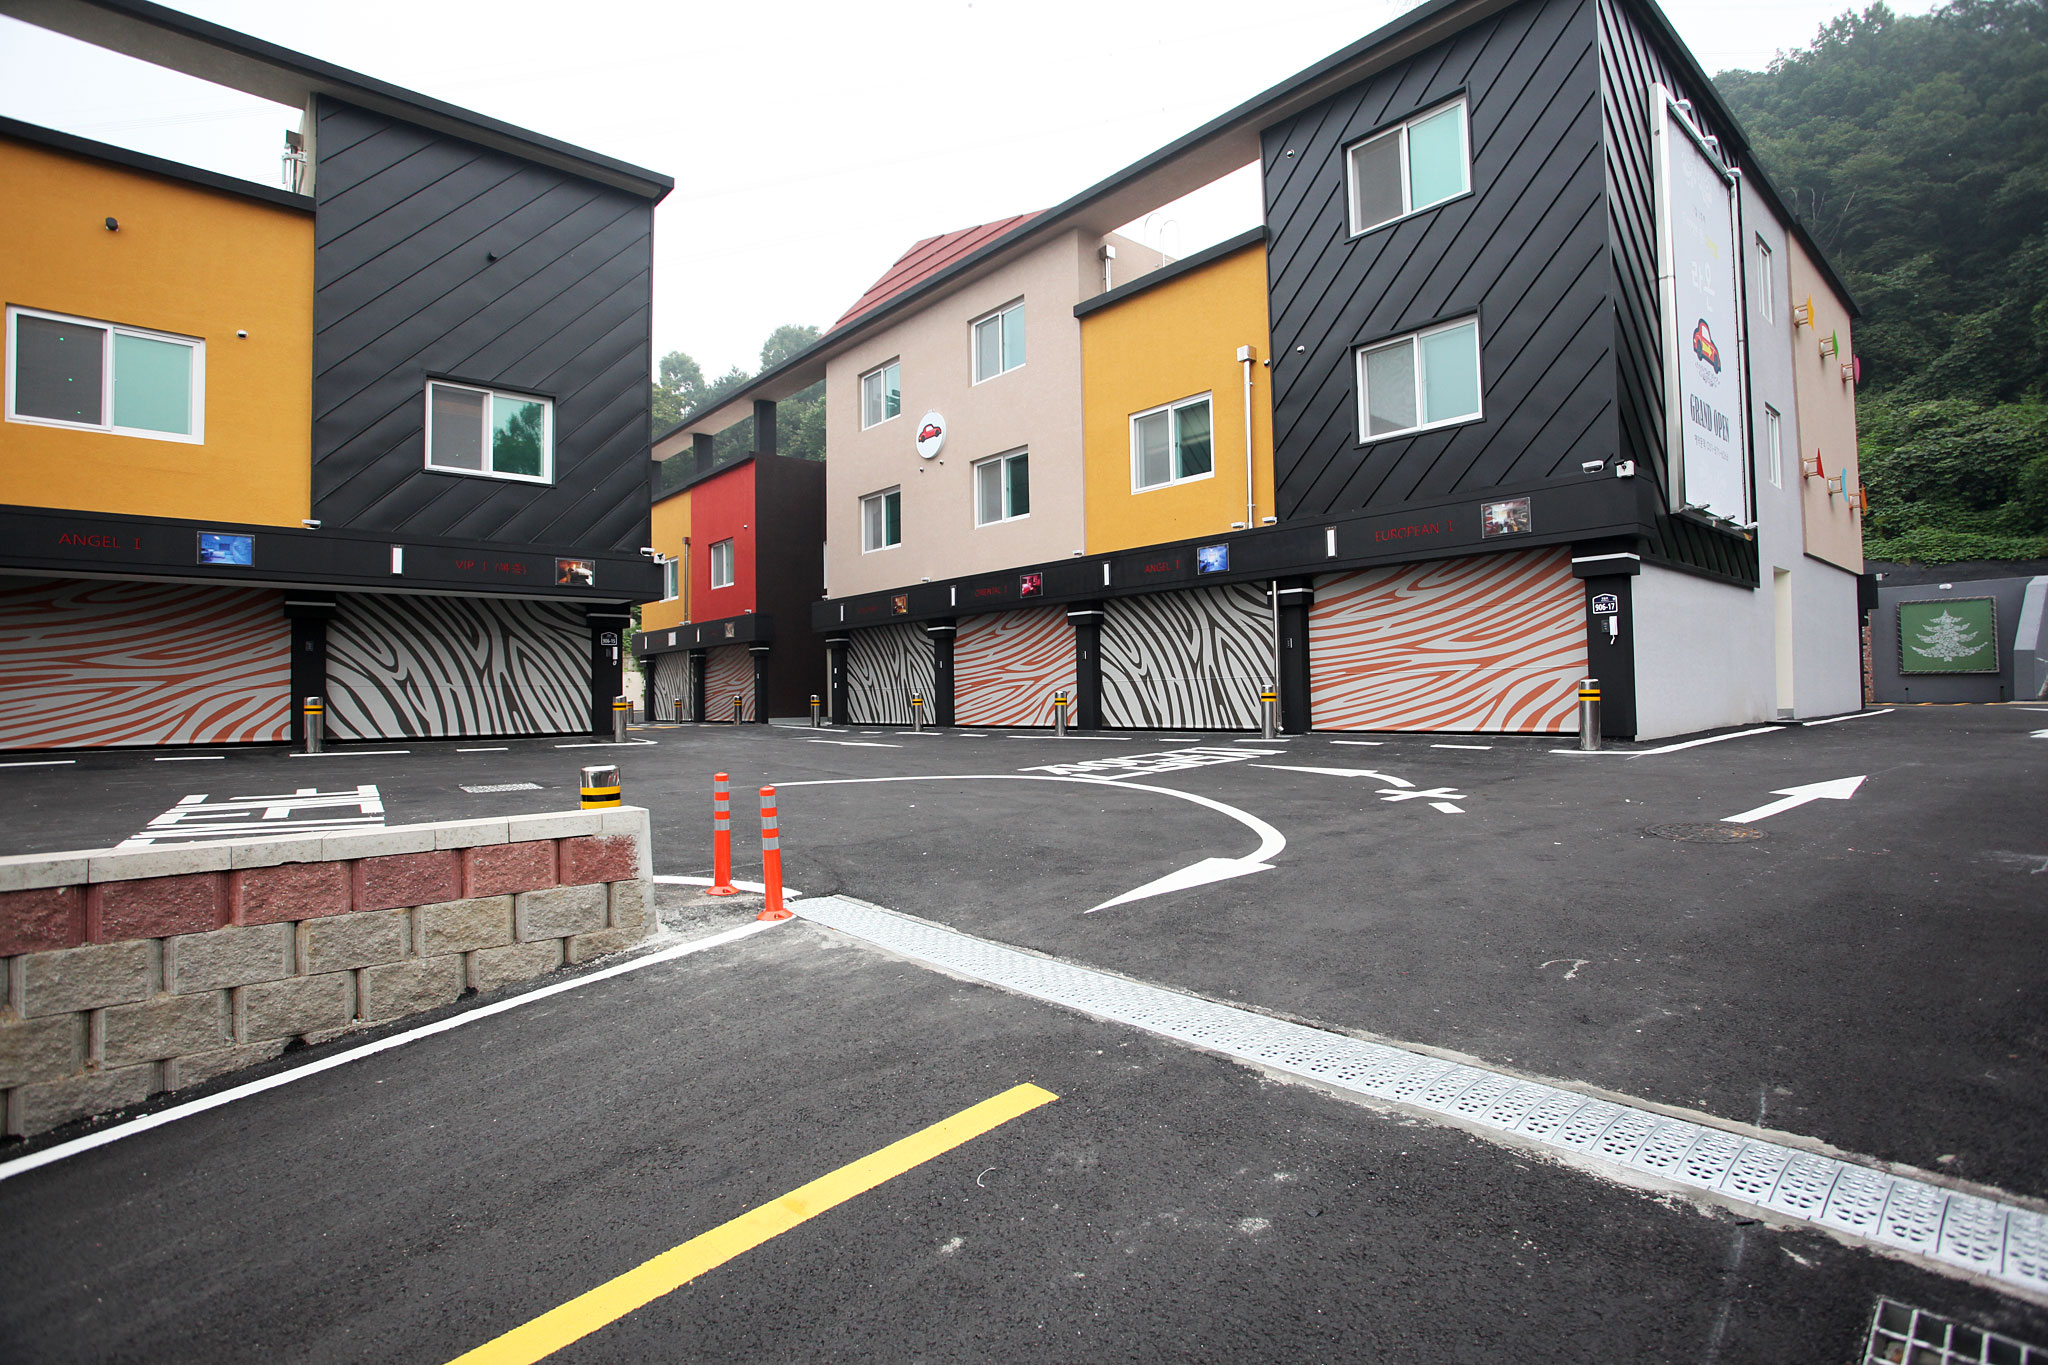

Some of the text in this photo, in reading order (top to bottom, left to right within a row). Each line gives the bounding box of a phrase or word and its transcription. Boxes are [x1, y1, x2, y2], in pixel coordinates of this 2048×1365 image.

[1690, 393, 1730, 443] GRAND OPEN
[1375, 522, 1439, 542] EUROPEAN
[58, 533, 121, 549] ANGEL
[455, 559, 476, 571] VIP
[1144, 561, 1172, 574] ANGEL
[1594, 602, 1615, 612] 906-17
